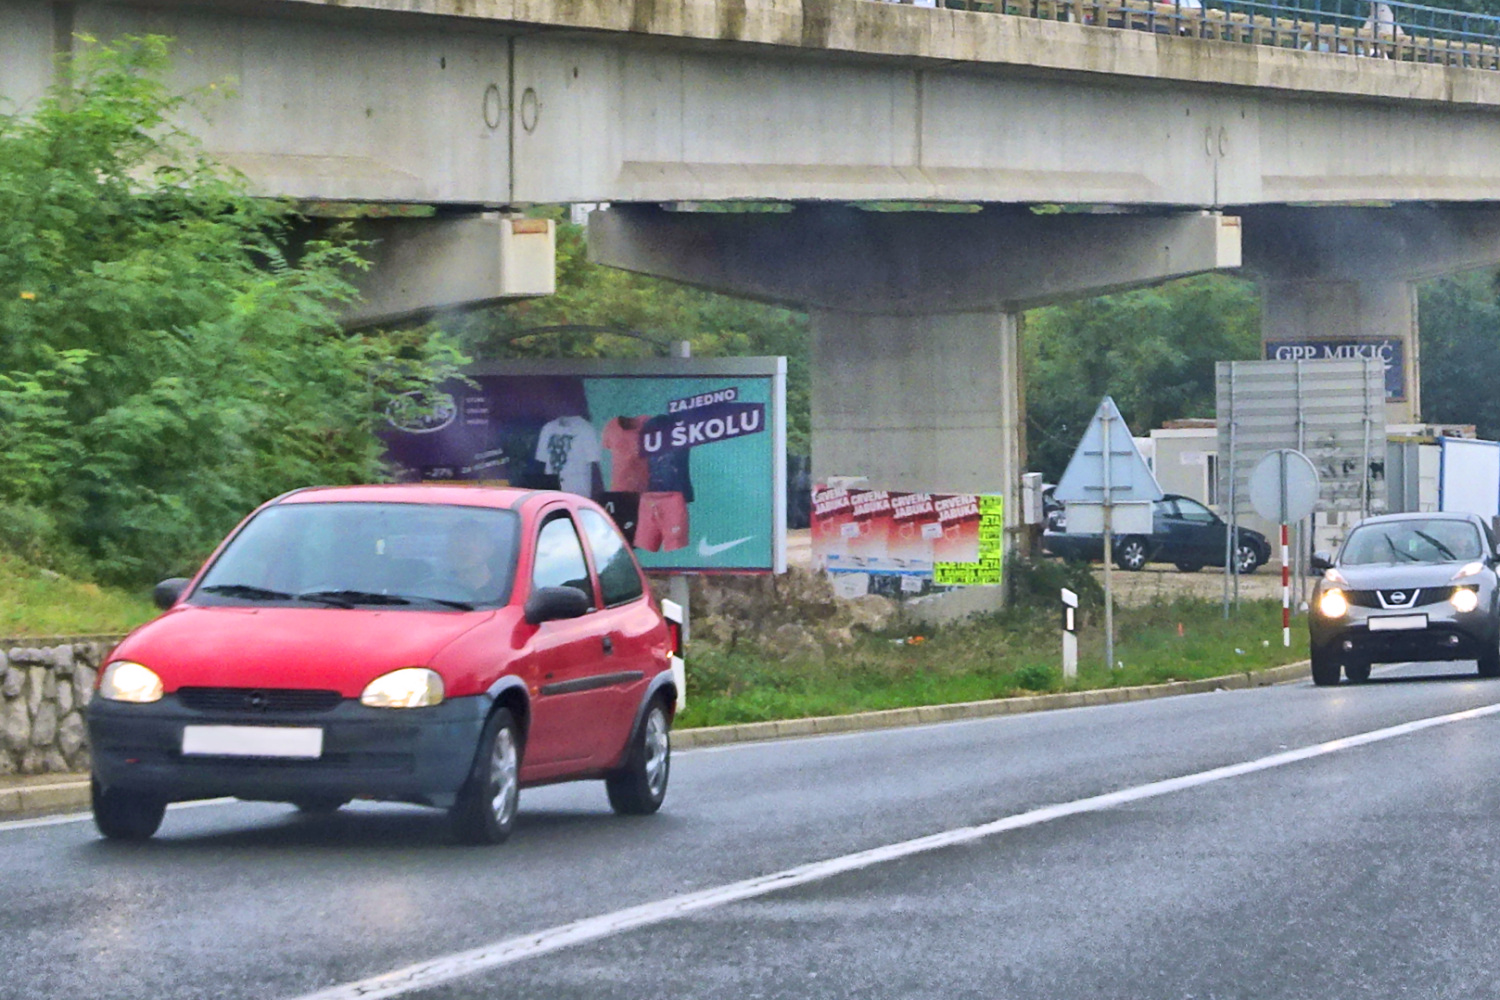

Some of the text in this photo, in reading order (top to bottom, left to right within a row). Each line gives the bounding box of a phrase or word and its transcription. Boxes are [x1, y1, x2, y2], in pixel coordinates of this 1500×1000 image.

[1276, 340, 1393, 363] GPP MIKIĆ
[669, 389, 735, 413] ZAJEDNO
[644, 410, 760, 452] U ŠKOLU
[815, 496, 850, 515] JABUKA
[850, 490, 889, 506] CRVENA
[891, 493, 932, 509] CRVENA
[935, 495, 977, 512] CRVENA
[853, 499, 891, 516] JABUKA
[893, 502, 934, 519] JABUKA
[937, 503, 979, 522] JABUKA
